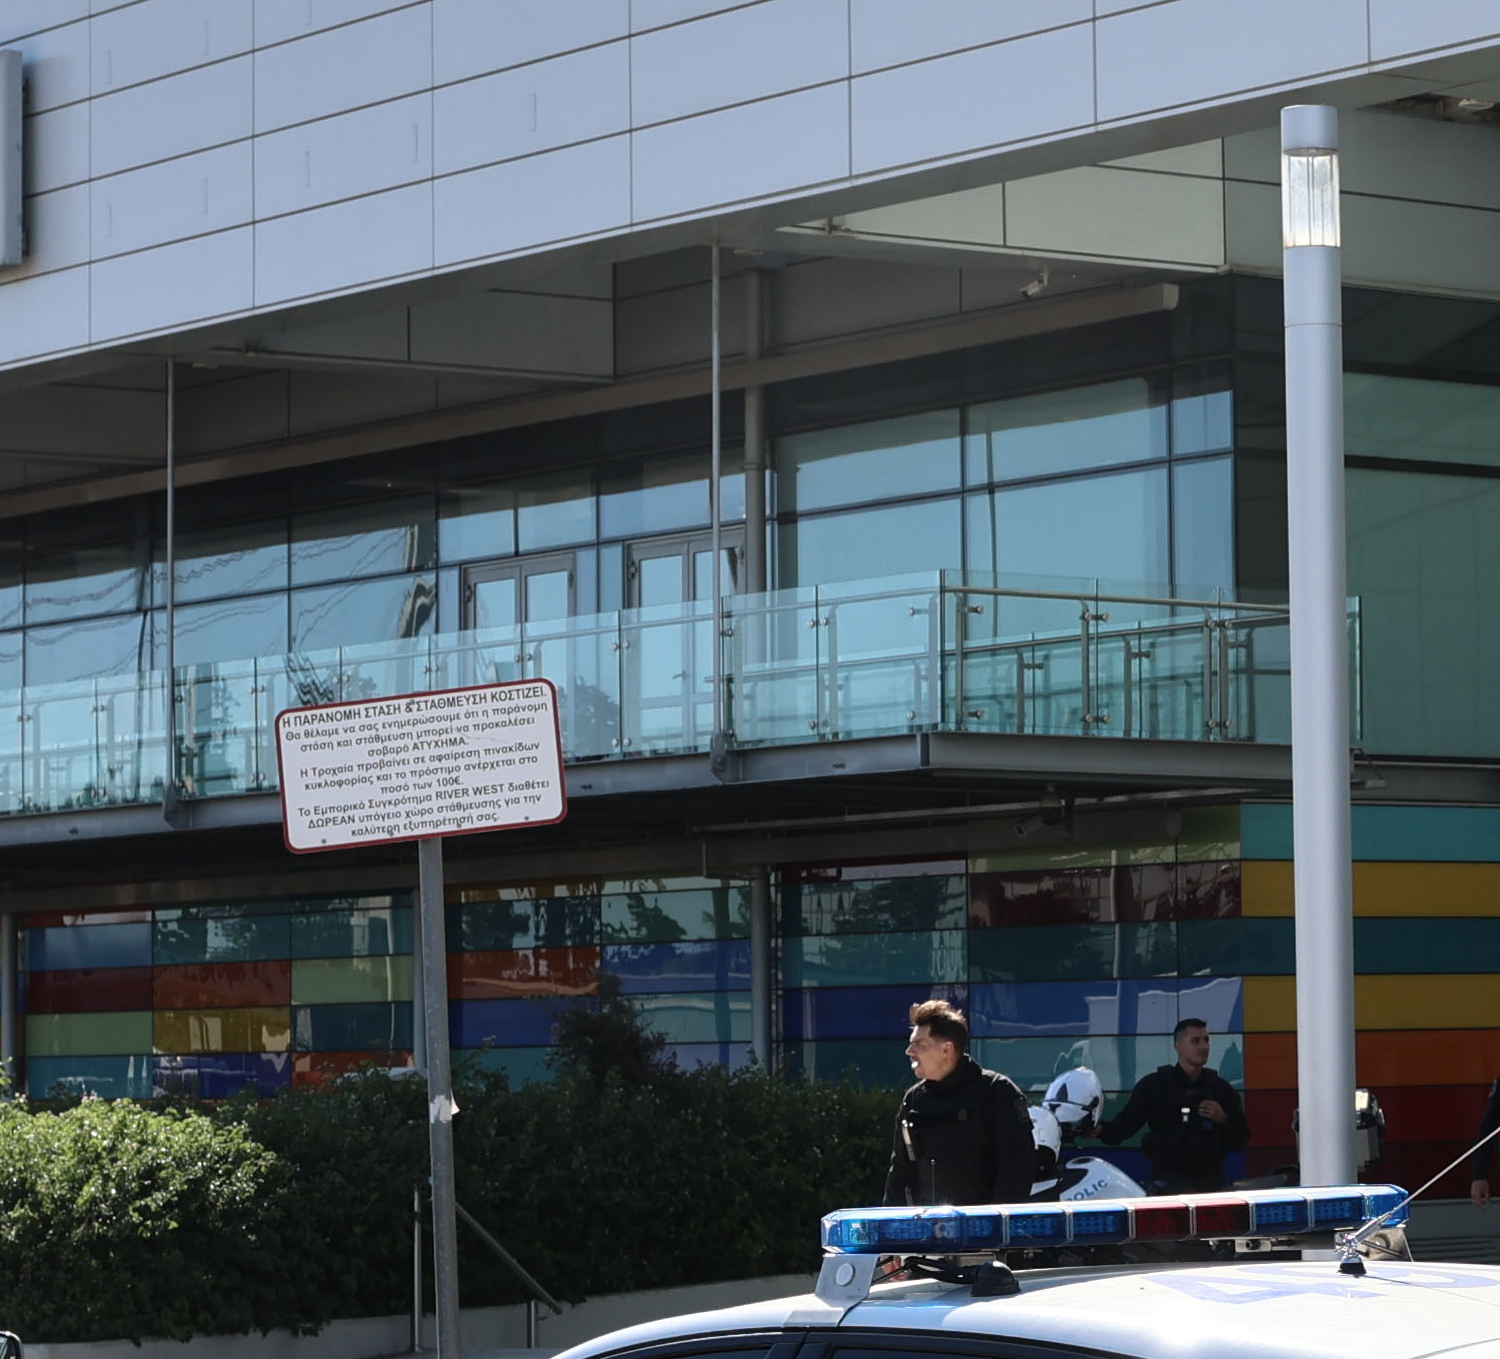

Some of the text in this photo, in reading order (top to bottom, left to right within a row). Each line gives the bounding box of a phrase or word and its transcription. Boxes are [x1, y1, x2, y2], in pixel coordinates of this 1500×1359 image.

[282, 718, 291, 729] Η
[294, 708, 361, 727] ΠΑΡΑΝΟΜΗ
[364, 703, 401, 719] ΣΤΑΣΗ
[416, 693, 487, 712] ΣΤΑΘΜΕΥΣΗ
[491, 686, 547, 703] ΚΟΣΤΙΖΕΙ.
[285, 731, 301, 741] Θα
[303, 727, 339, 740] θέλαμε
[343, 725, 356, 734] να
[358, 722, 378, 733] σας
[463, 709, 479, 719] ότι
[492, 701, 548, 717] παράνομη
[300, 717, 535, 752] στάση και στάθμευση μπορεί να προκαλέσει
[367, 736, 469, 758] σοβαρό ΑΤΥΧΗΜΑ.
[300, 741, 540, 778] Η Τροχαία προβαίνει σε αφαίρεση πινακίδων
[305, 755, 538, 791] κυκλοφορίας και το πρόστιμο ανέρχεται στο
[298, 779, 550, 818] Το Εμπορικό Συγκρότημα RIVER WEST διαθέτει
[380, 784, 410, 795] ποσό
[412, 781, 433, 790] των
[308, 793, 542, 829] ΔΩΡΕΑΝ υπόγειο χώρο στάθμευσης για την
[351, 822, 401, 837] καλύτερη
